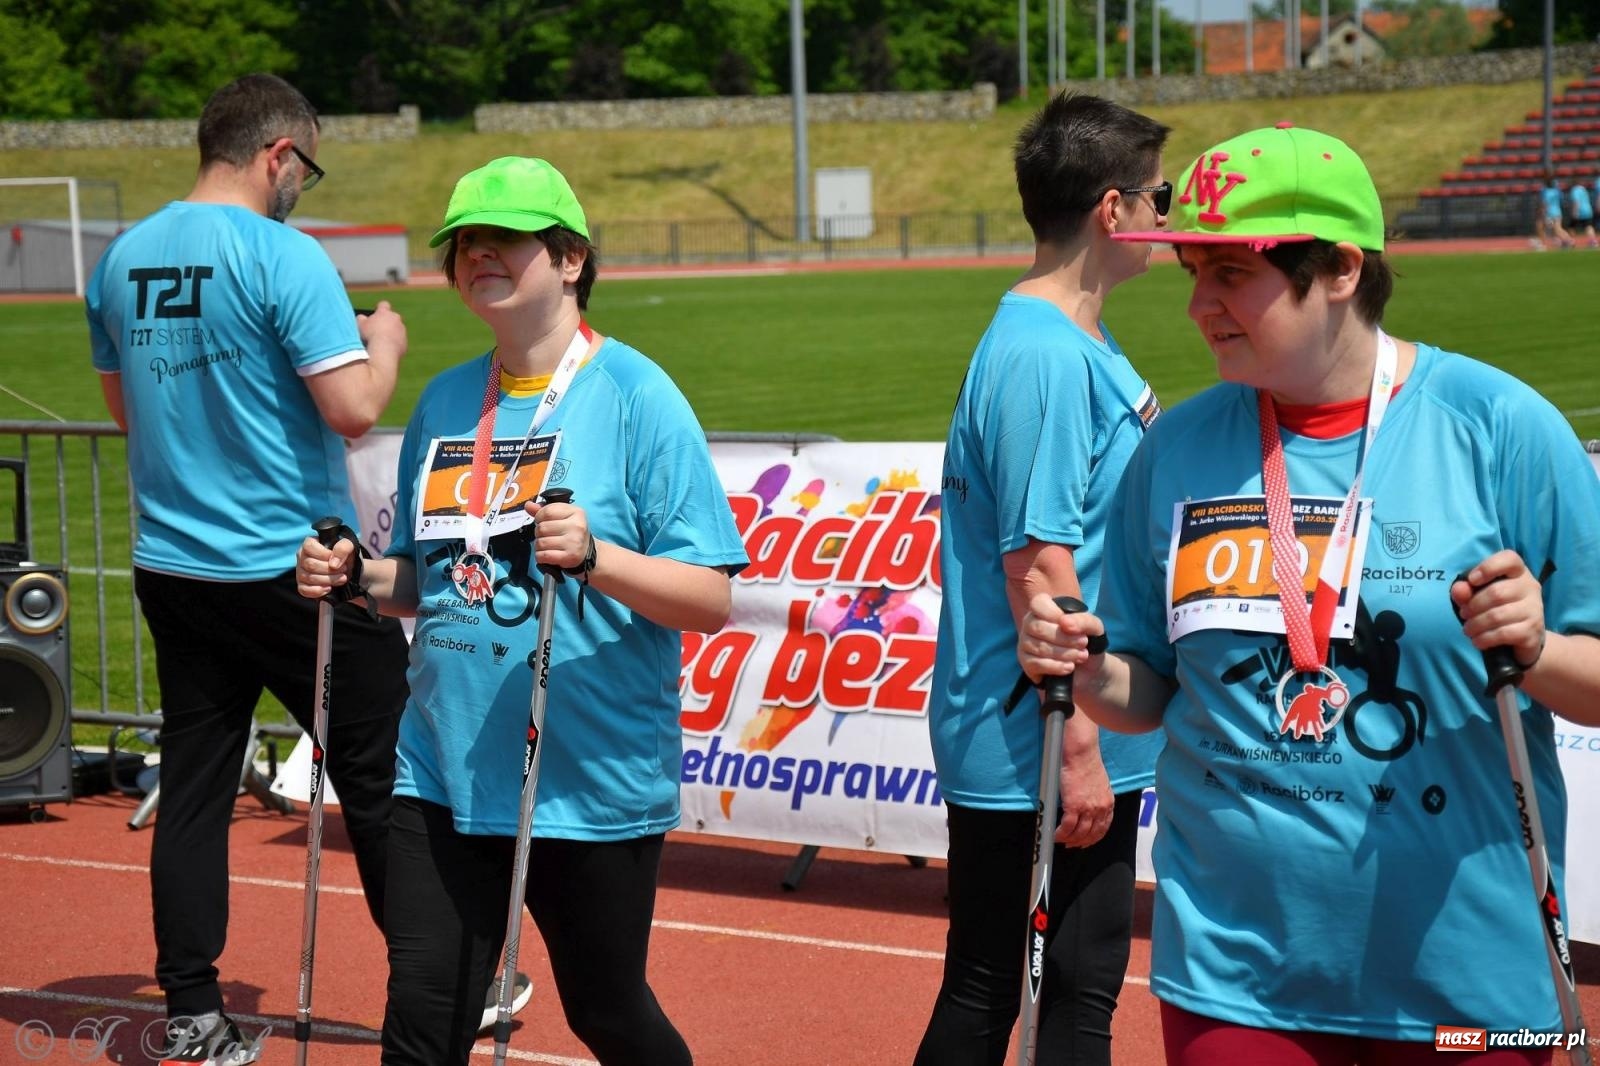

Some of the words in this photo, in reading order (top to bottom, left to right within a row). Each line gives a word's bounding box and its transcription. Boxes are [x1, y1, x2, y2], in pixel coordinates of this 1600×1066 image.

[1178, 151, 1247, 225] NY
[156, 327, 218, 346] SYSTEM
[150, 346, 243, 384] Pomagamy
[1207, 504, 1265, 515] RACIBORSKI
[1292, 505, 1312, 514] BEZ
[1313, 506, 1341, 515] BARI
[1361, 566, 1446, 582] Racibórz
[1389, 585, 1413, 597] 1217
[429, 635, 477, 654] Racibórz
[762, 599, 937, 714] bez
[1239, 747, 1343, 765] WIŚNIEWSKIEGO
[1261, 781, 1345, 804] Racibórz
